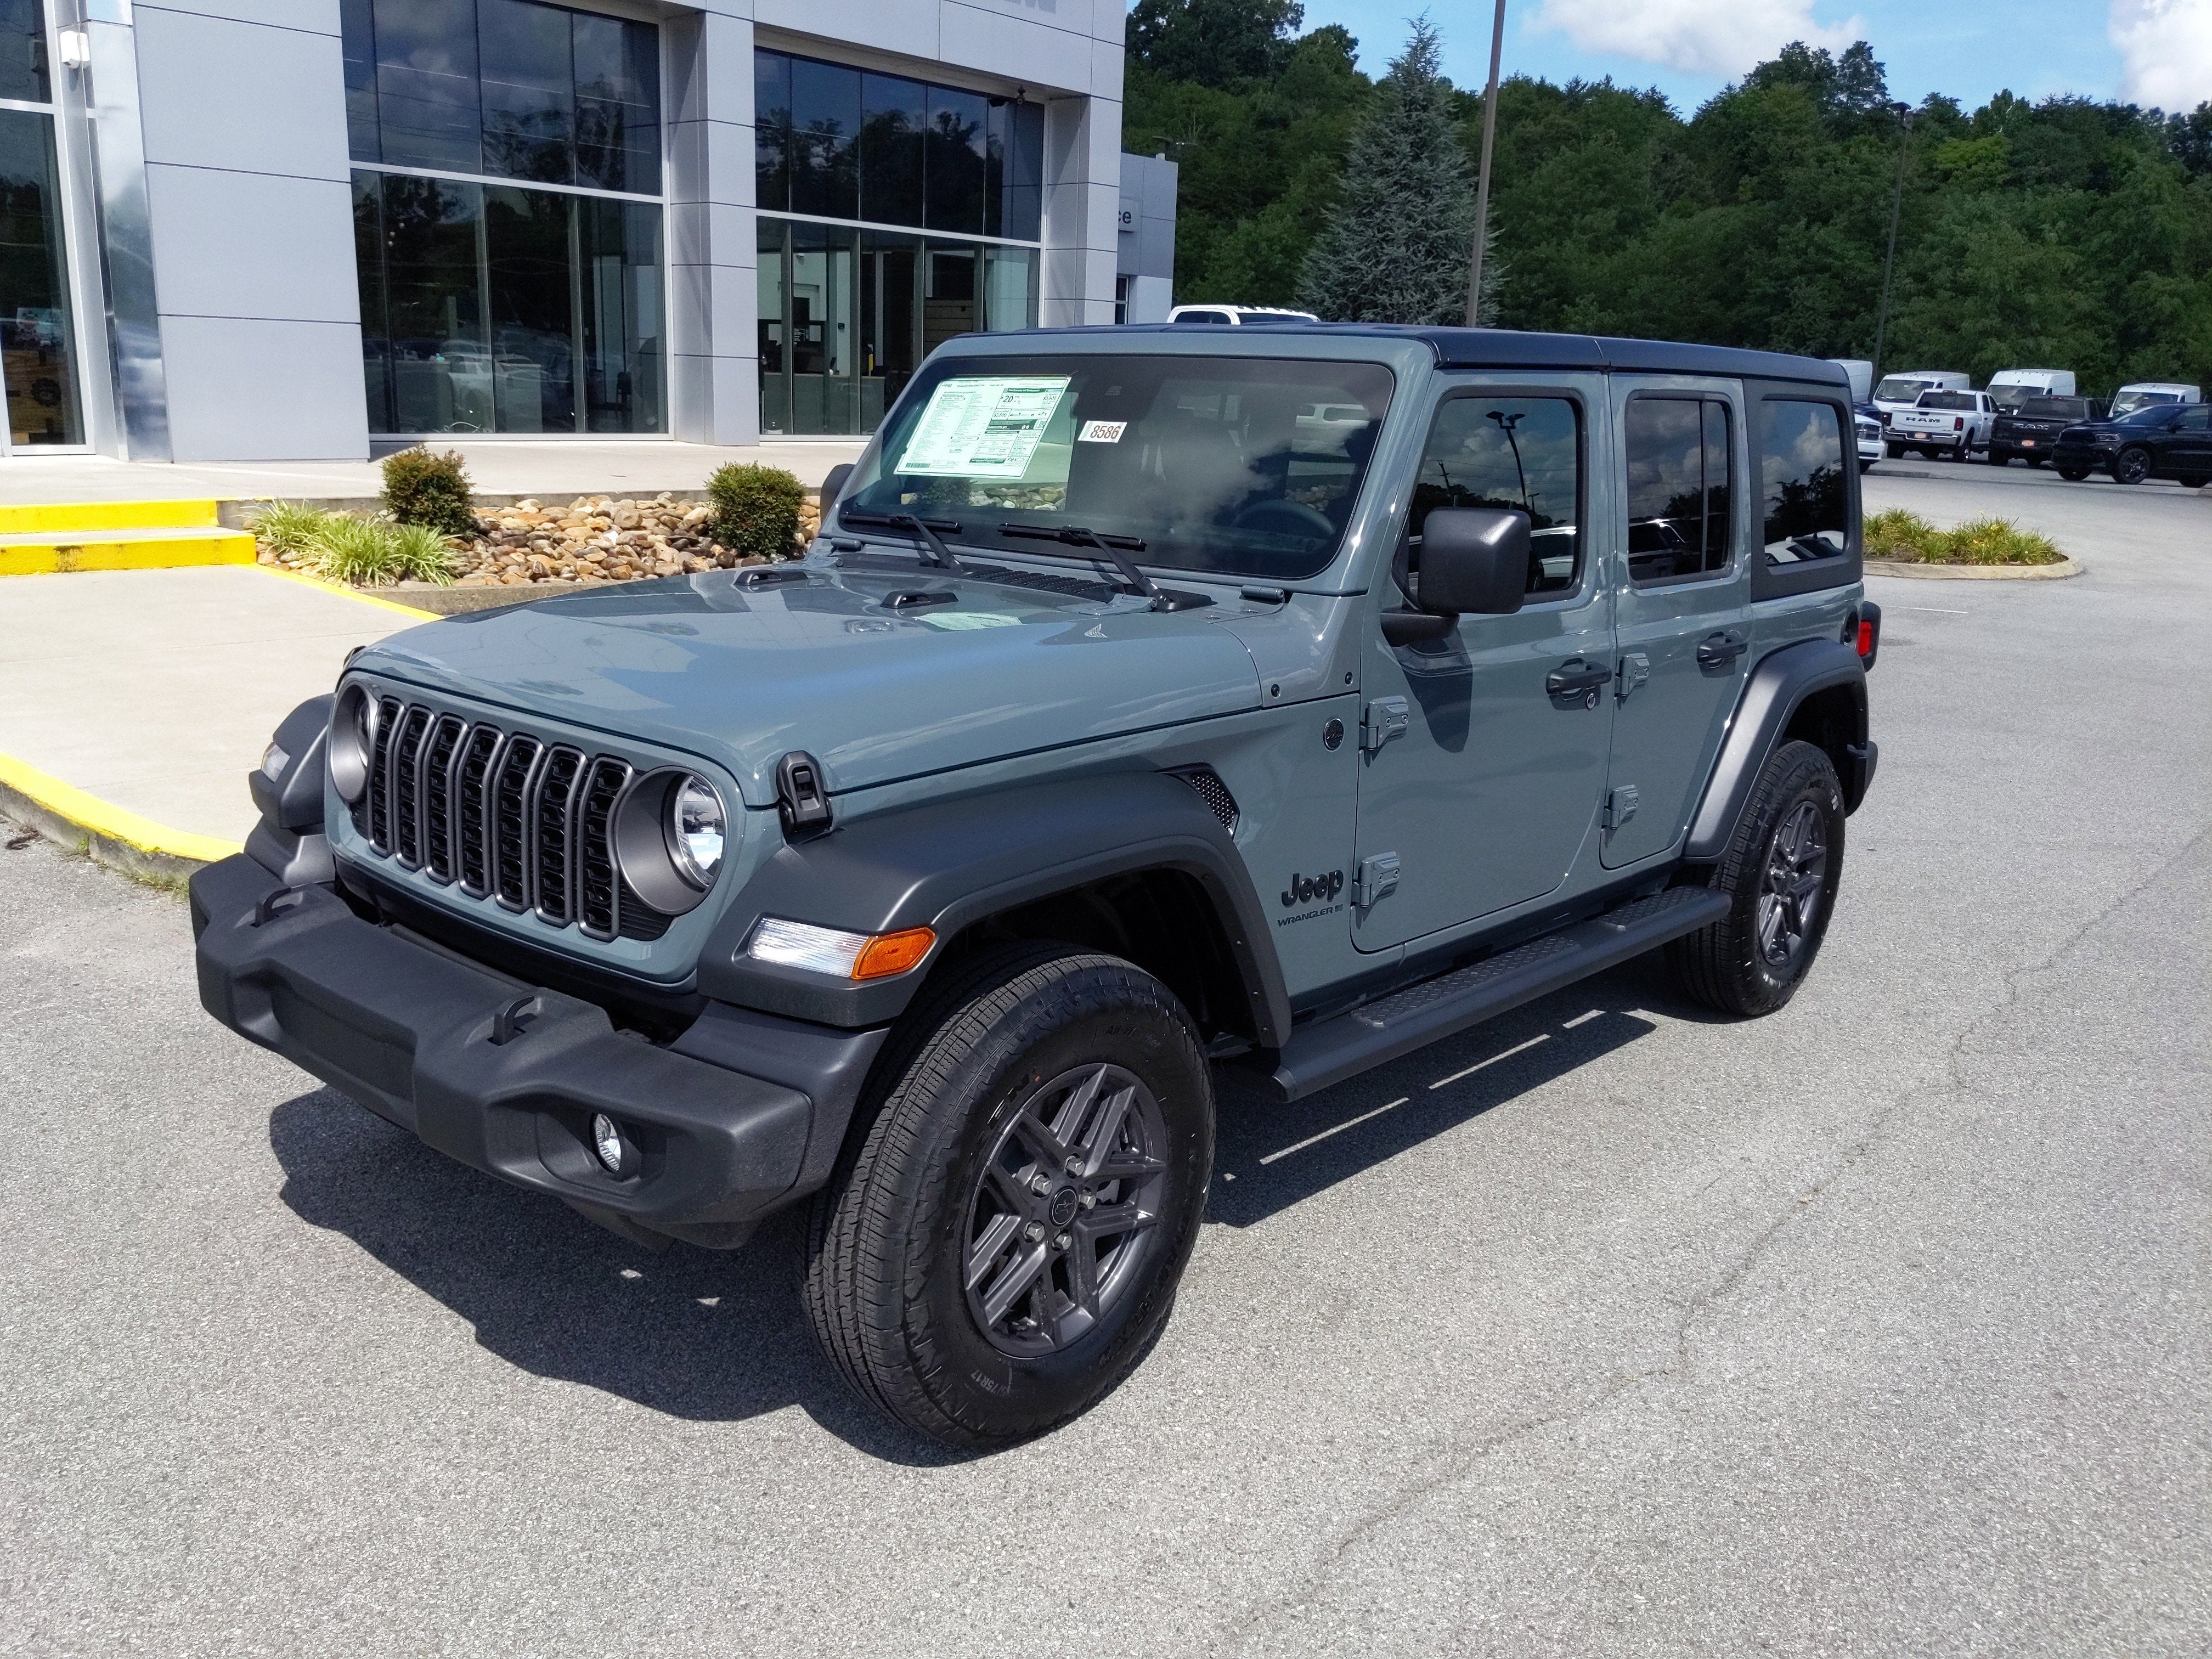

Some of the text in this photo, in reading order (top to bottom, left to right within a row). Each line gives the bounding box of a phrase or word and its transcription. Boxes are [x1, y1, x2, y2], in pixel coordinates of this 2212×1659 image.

[1090, 425, 1121, 439] 8586
[1281, 870, 1344, 907] Jeep
[1277, 907, 1333, 927] WRANGLER
